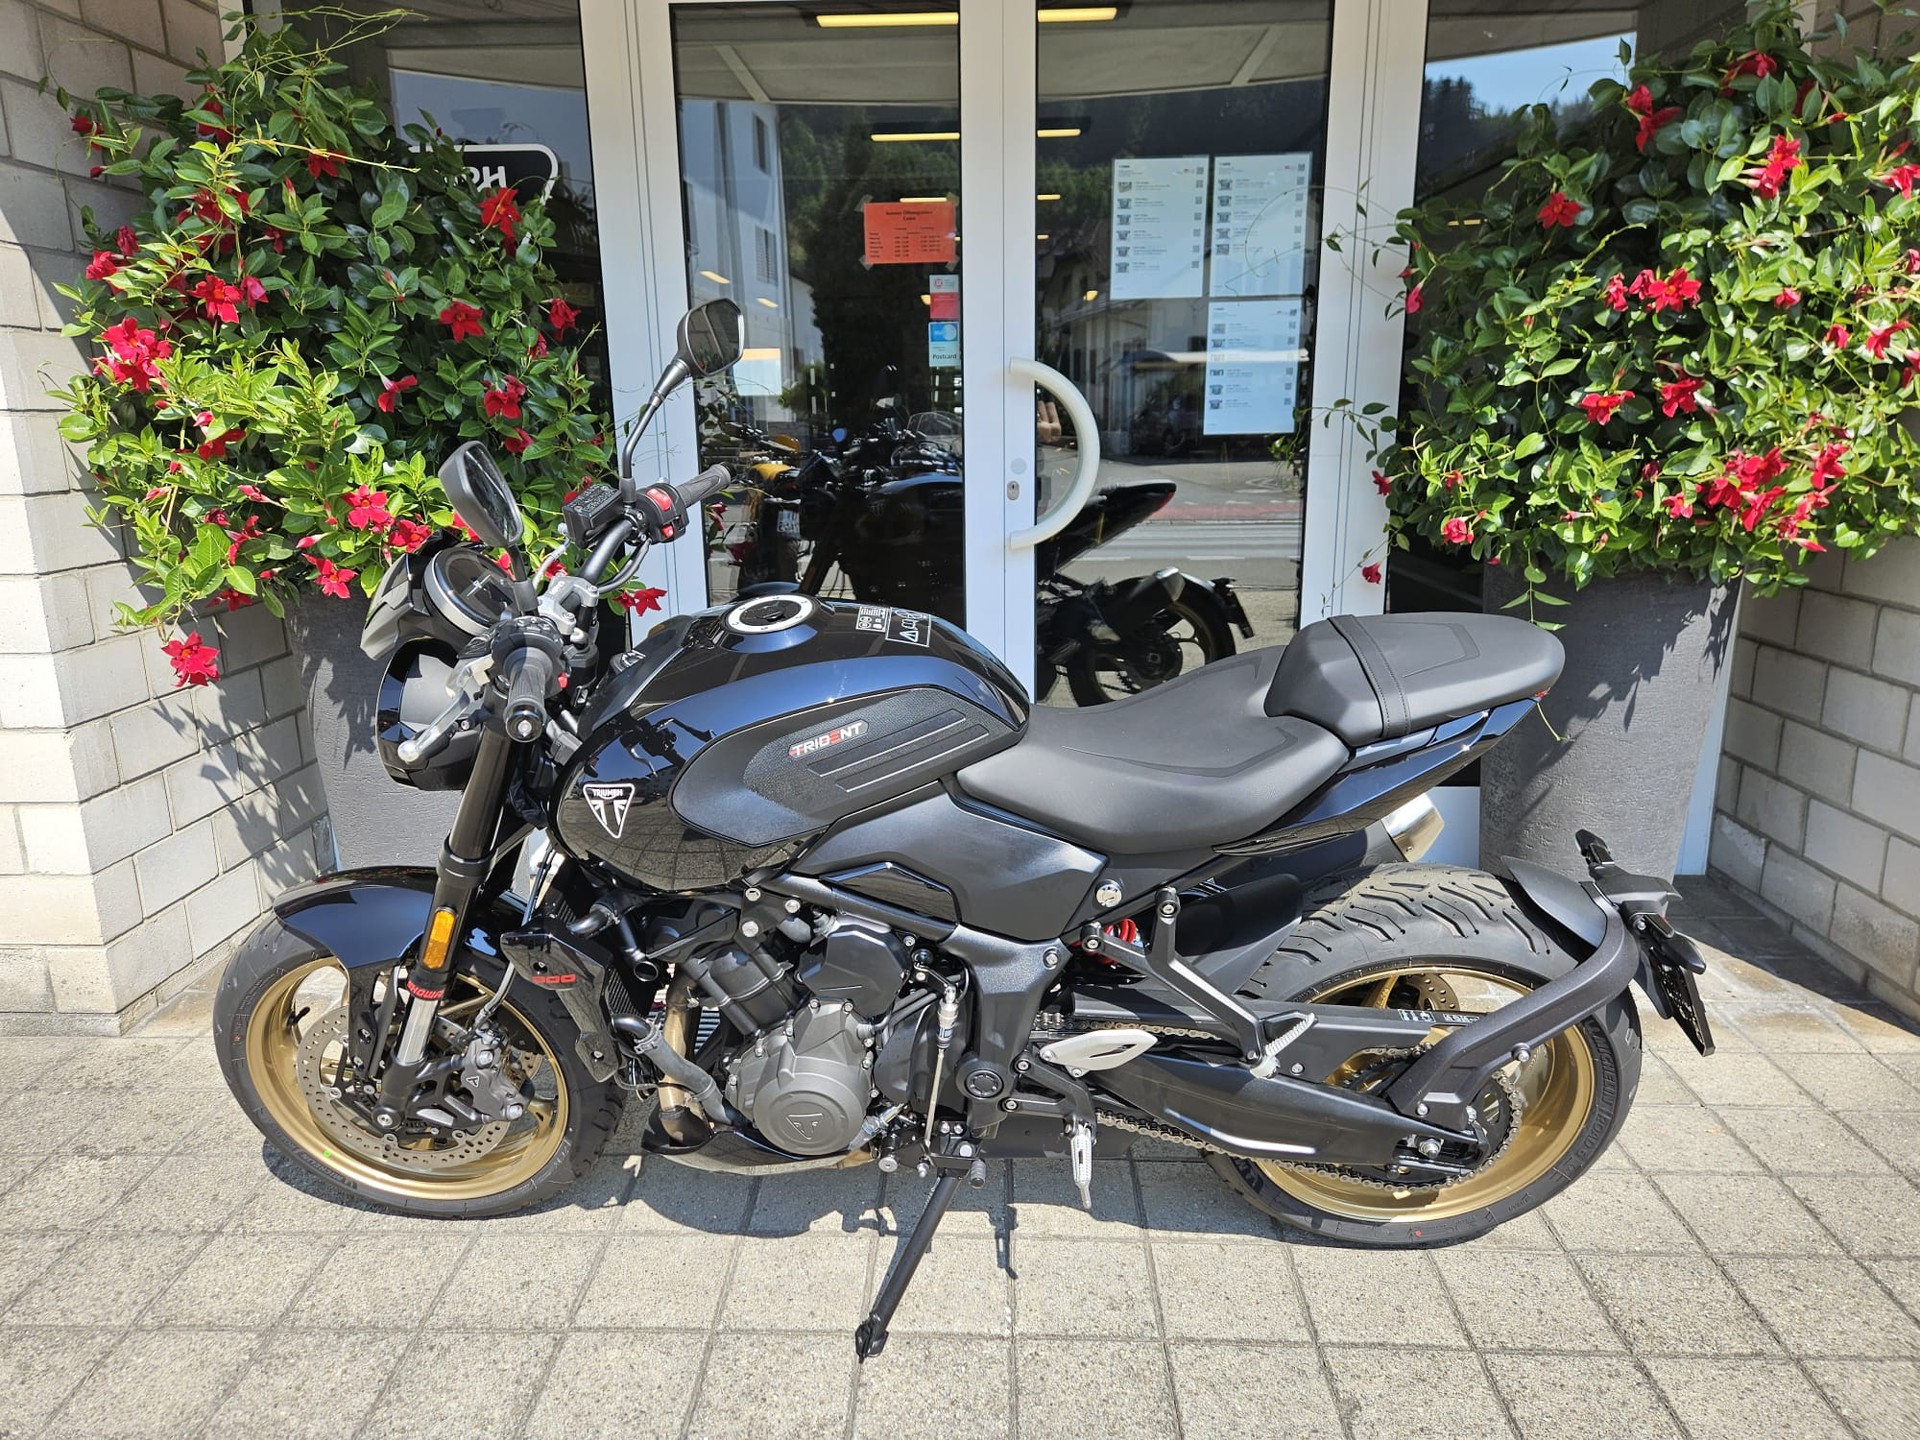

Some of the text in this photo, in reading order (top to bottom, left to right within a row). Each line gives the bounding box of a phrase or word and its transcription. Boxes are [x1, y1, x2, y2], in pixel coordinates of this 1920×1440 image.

[792, 722, 862, 756] TRIDENT
[592, 788, 624, 797] TRIUMPH
[1593, 1034, 1617, 1105] MICHELIN
